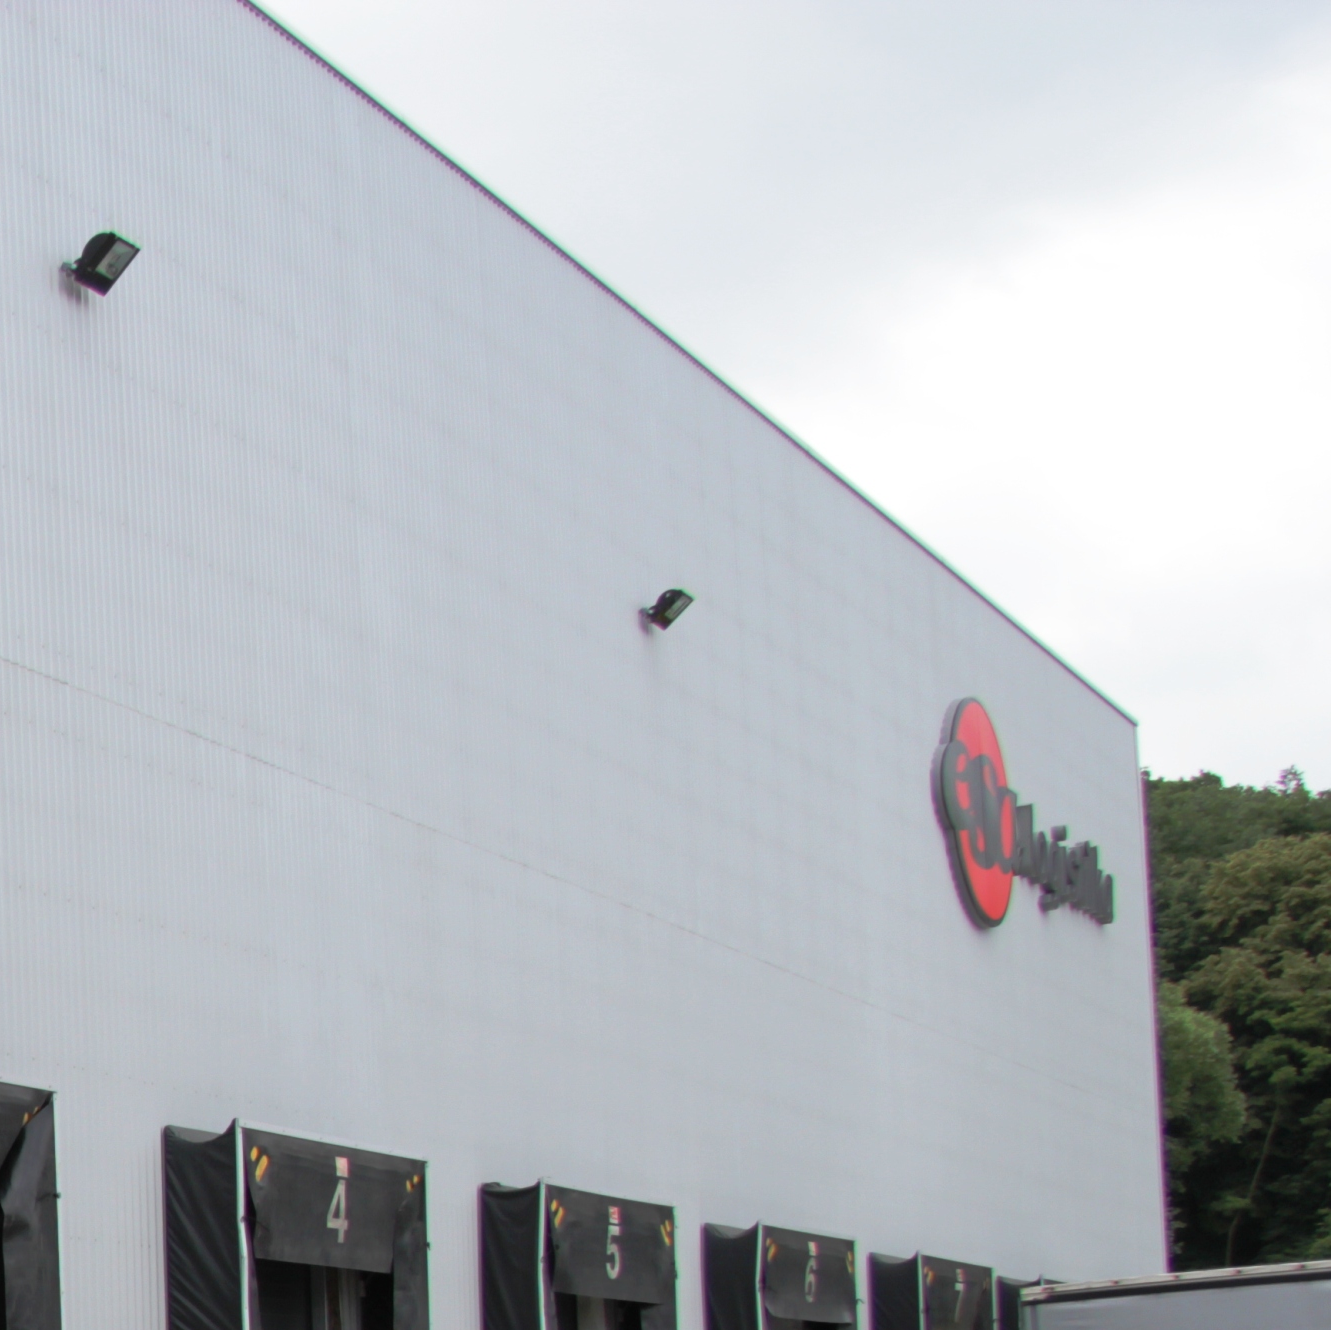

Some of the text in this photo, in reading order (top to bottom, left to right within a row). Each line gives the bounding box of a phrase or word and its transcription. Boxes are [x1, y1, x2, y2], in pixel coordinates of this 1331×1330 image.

[326, 1179, 348, 1244] 4
[606, 1225, 623, 1280] 5
[805, 1257, 818, 1303] 6
[954, 1282, 966, 1323] 7
